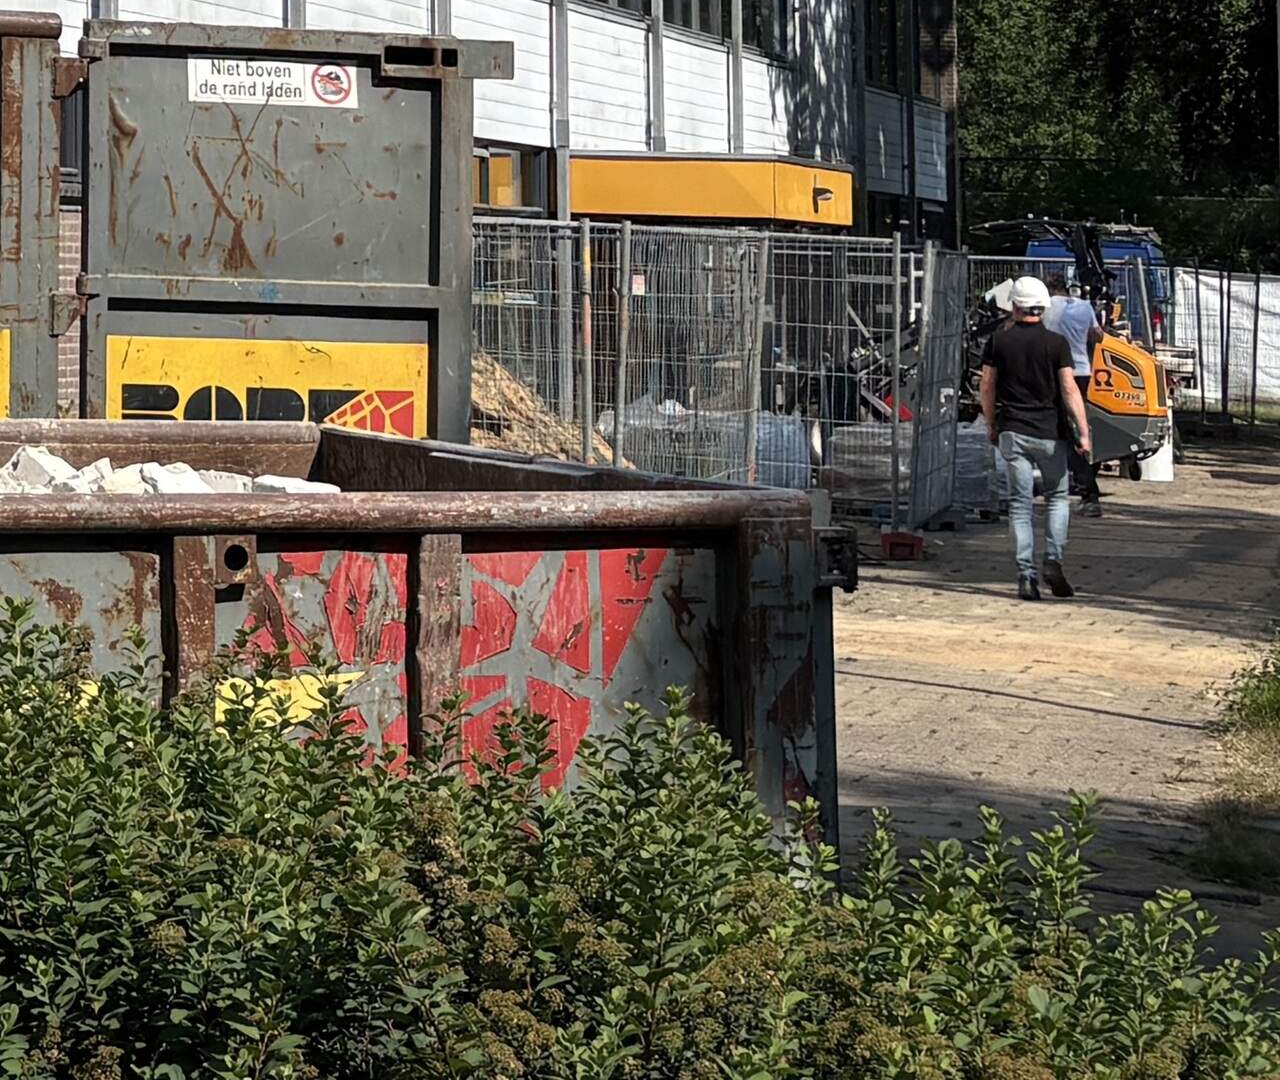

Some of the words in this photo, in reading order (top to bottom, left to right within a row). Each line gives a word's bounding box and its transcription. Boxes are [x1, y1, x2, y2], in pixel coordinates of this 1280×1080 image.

[211, 59, 241, 77] Niet
[246, 60, 292, 78] boven
[199, 80, 217, 95] de
[223, 81, 257, 97] rand
[262, 81, 303, 99] laden
